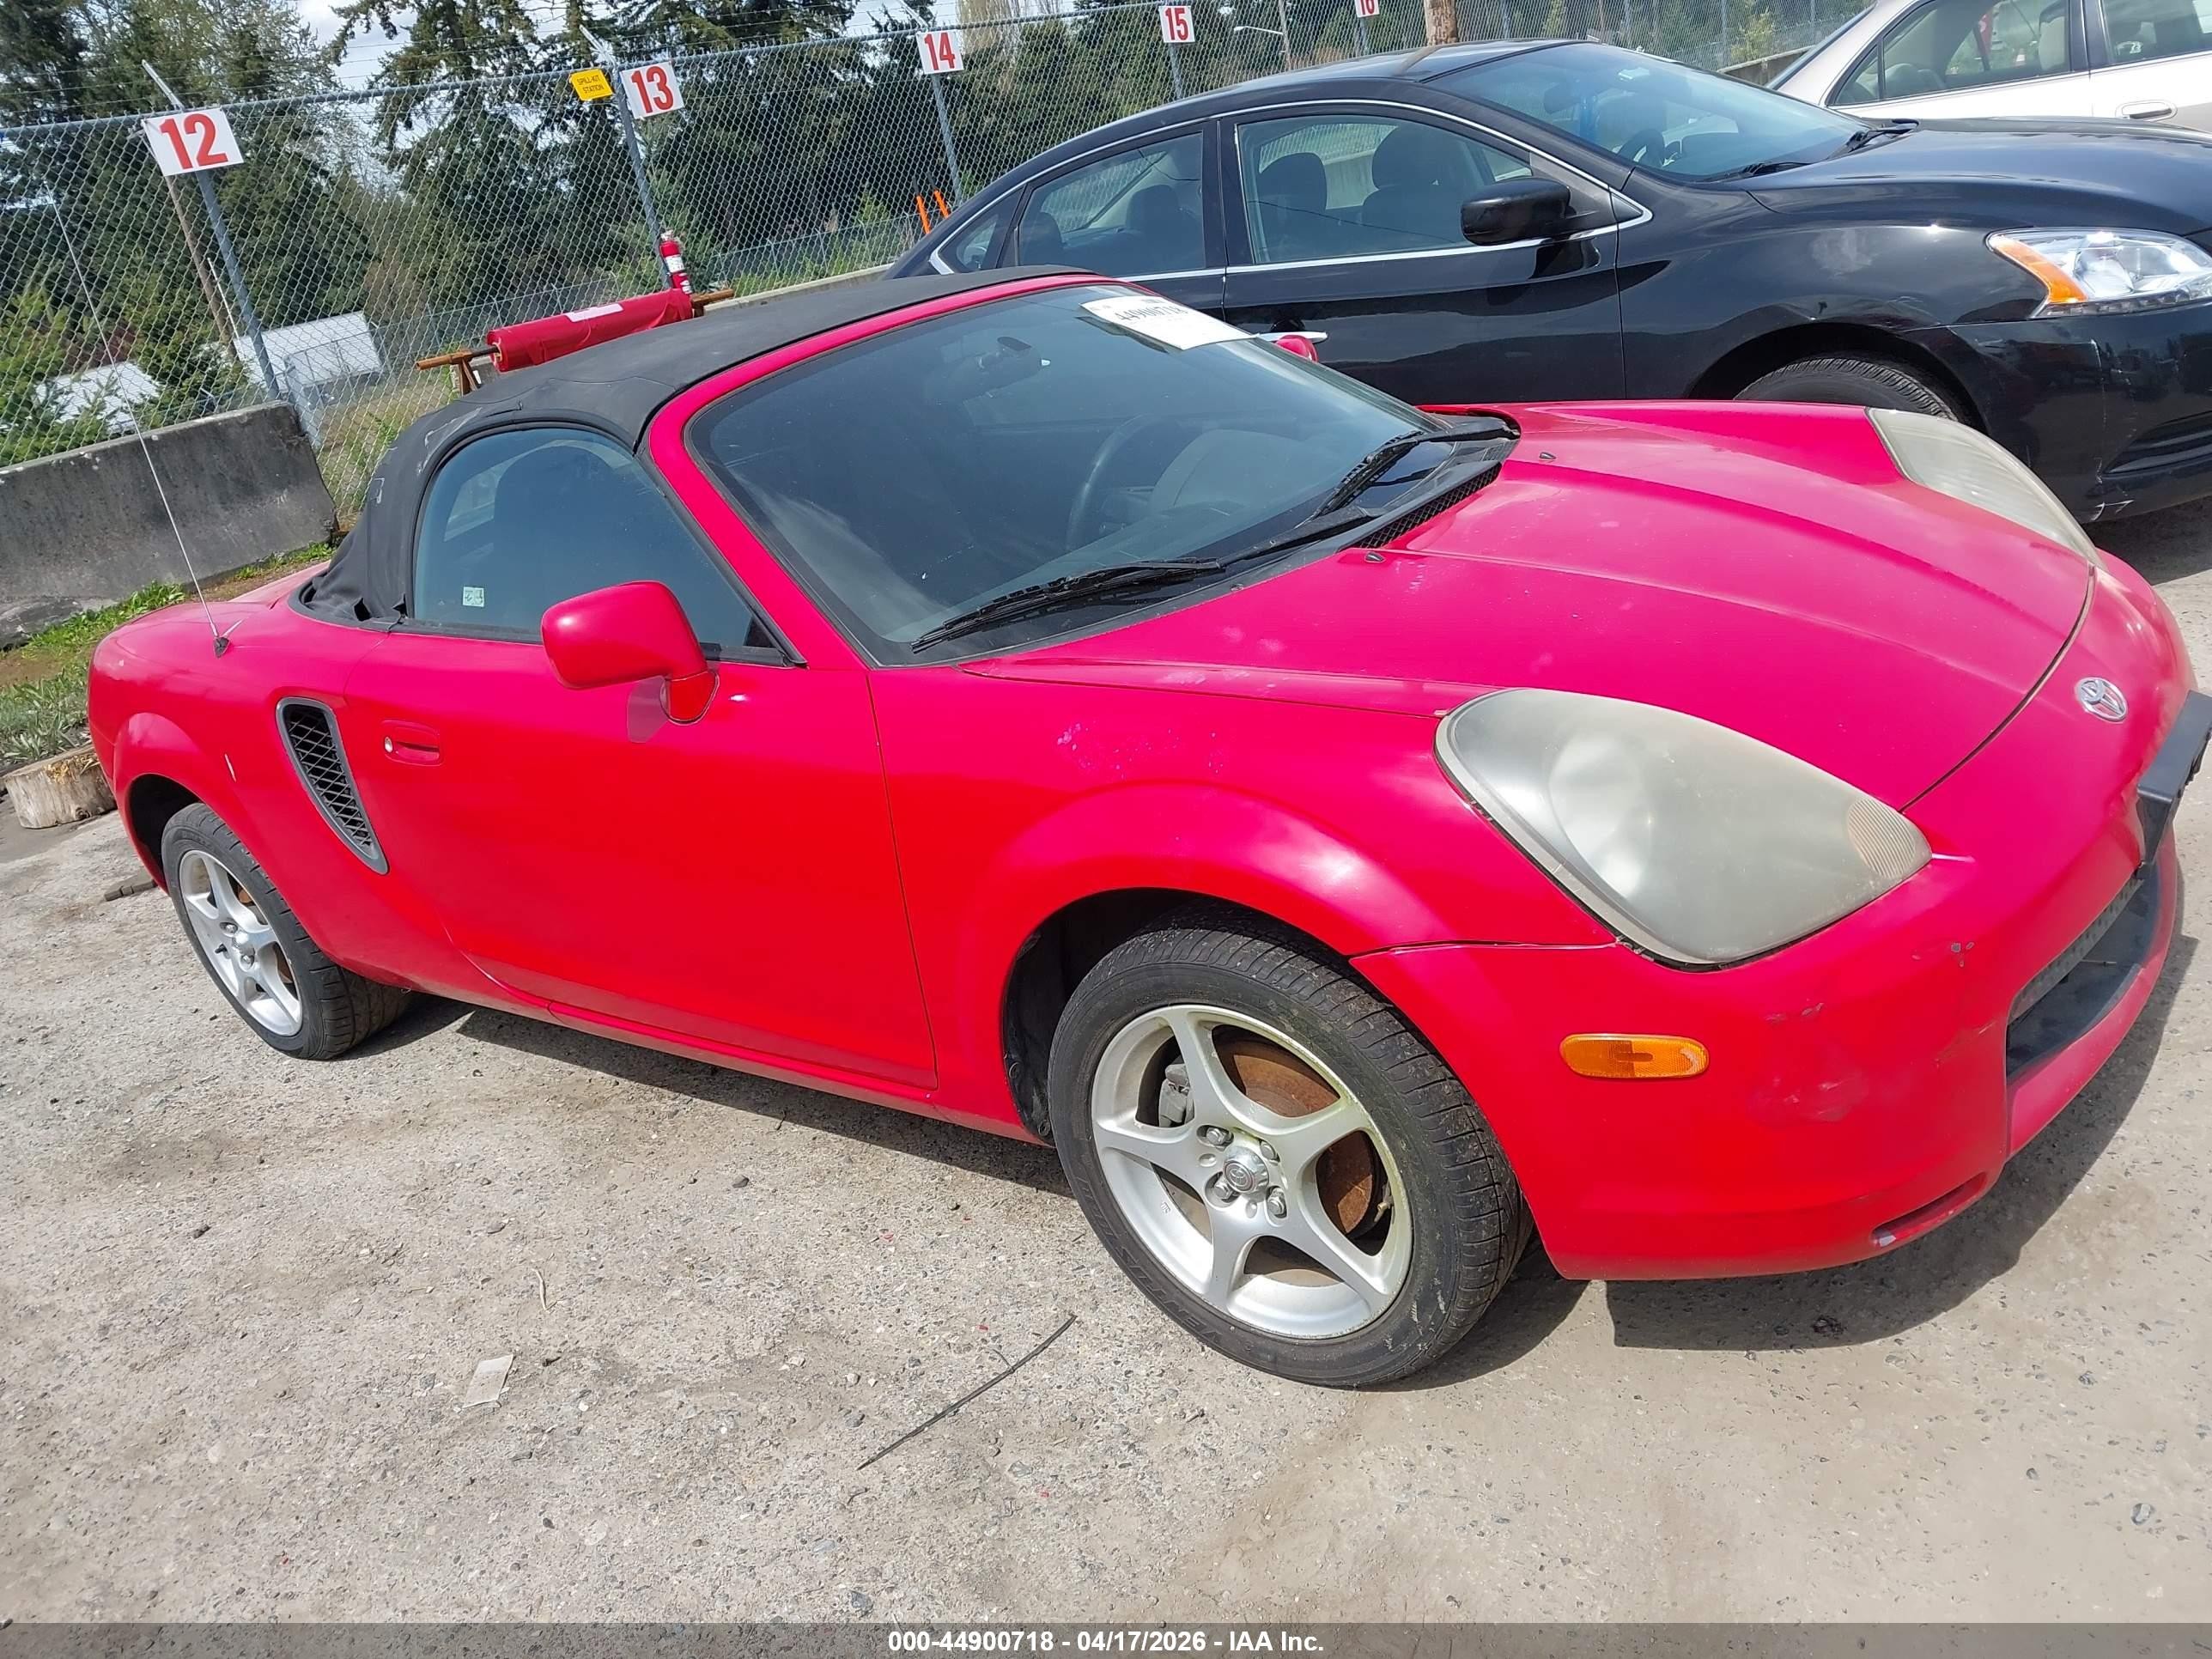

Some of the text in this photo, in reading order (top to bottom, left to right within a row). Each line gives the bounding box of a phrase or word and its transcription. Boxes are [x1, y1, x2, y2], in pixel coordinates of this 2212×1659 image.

[1165, 8, 1188, 40] 15
[924, 32, 956, 70] 14
[582, 84, 605, 94] STATION
[631, 65, 674, 113] 13
[160, 113, 228, 170] 12
